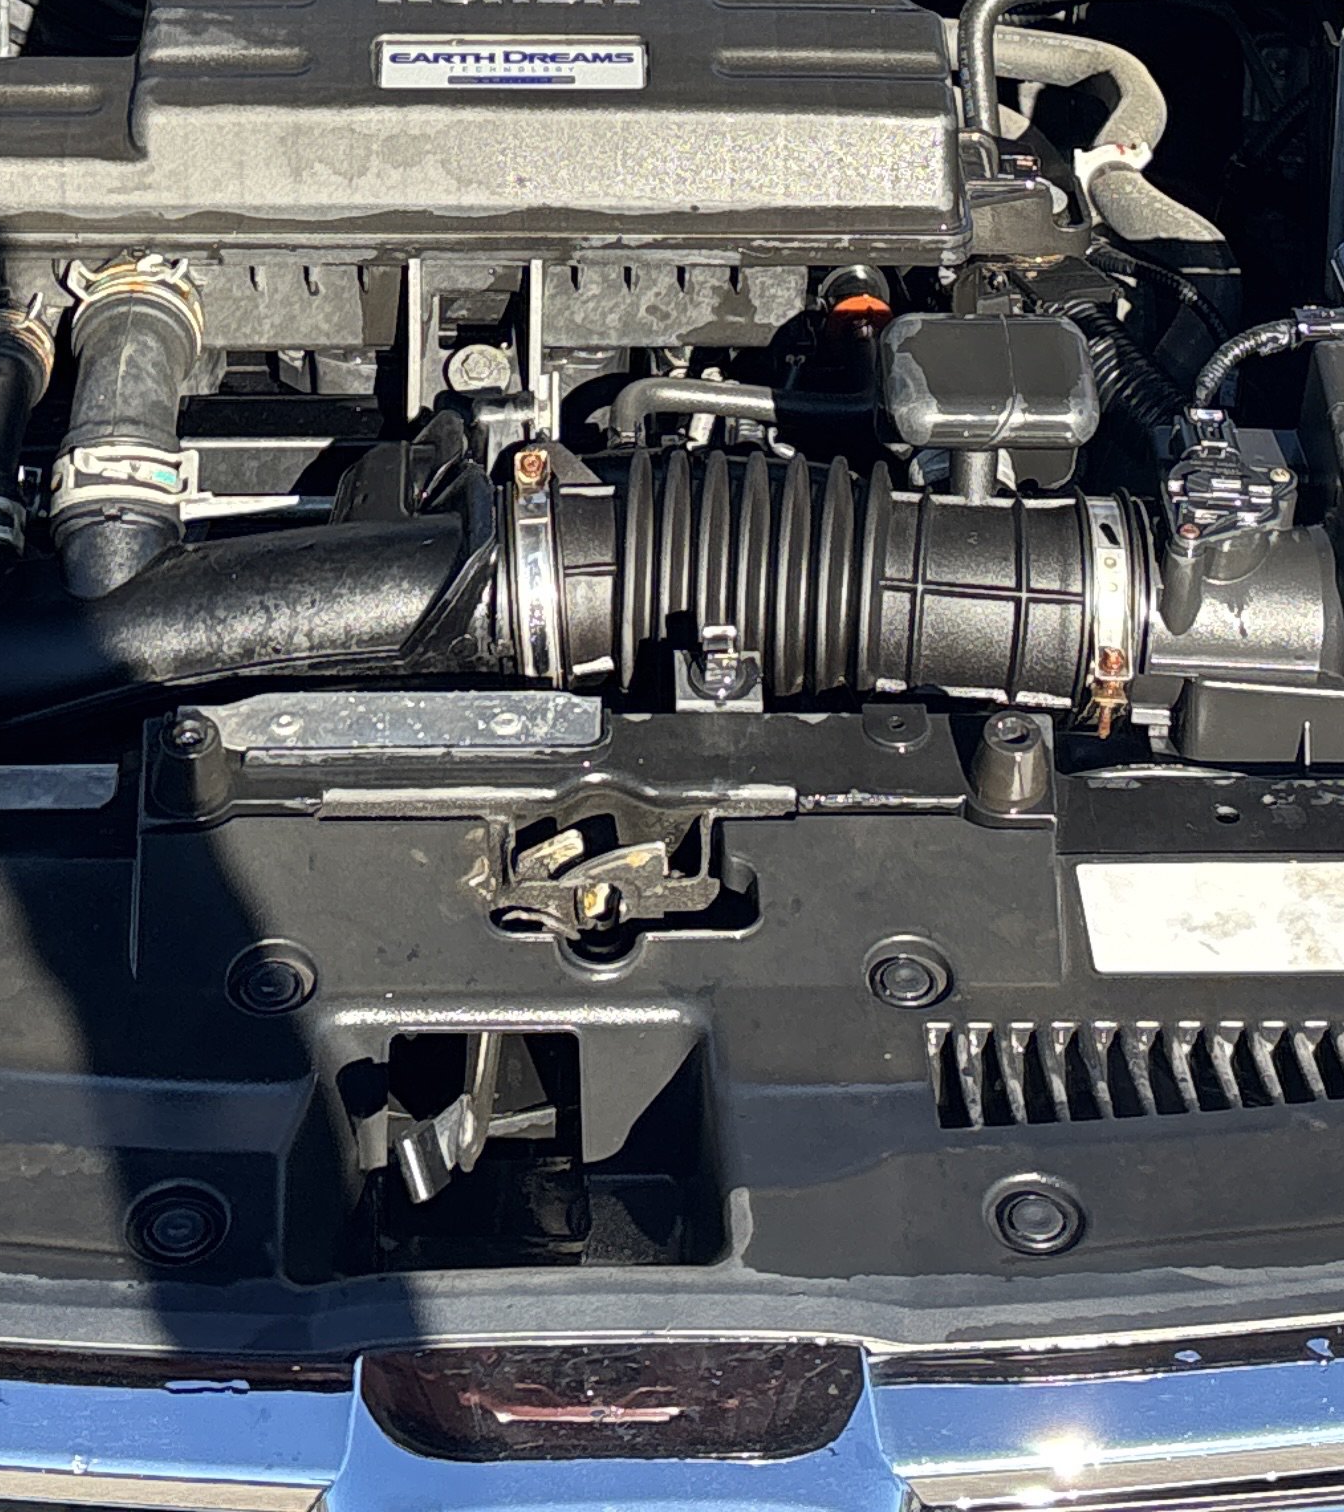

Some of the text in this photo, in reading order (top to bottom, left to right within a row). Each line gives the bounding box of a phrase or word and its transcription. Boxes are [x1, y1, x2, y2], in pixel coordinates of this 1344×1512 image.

[388, 49, 635, 64] EARTH DREAMS
[449, 65, 576, 73] TECHNOLOGY
